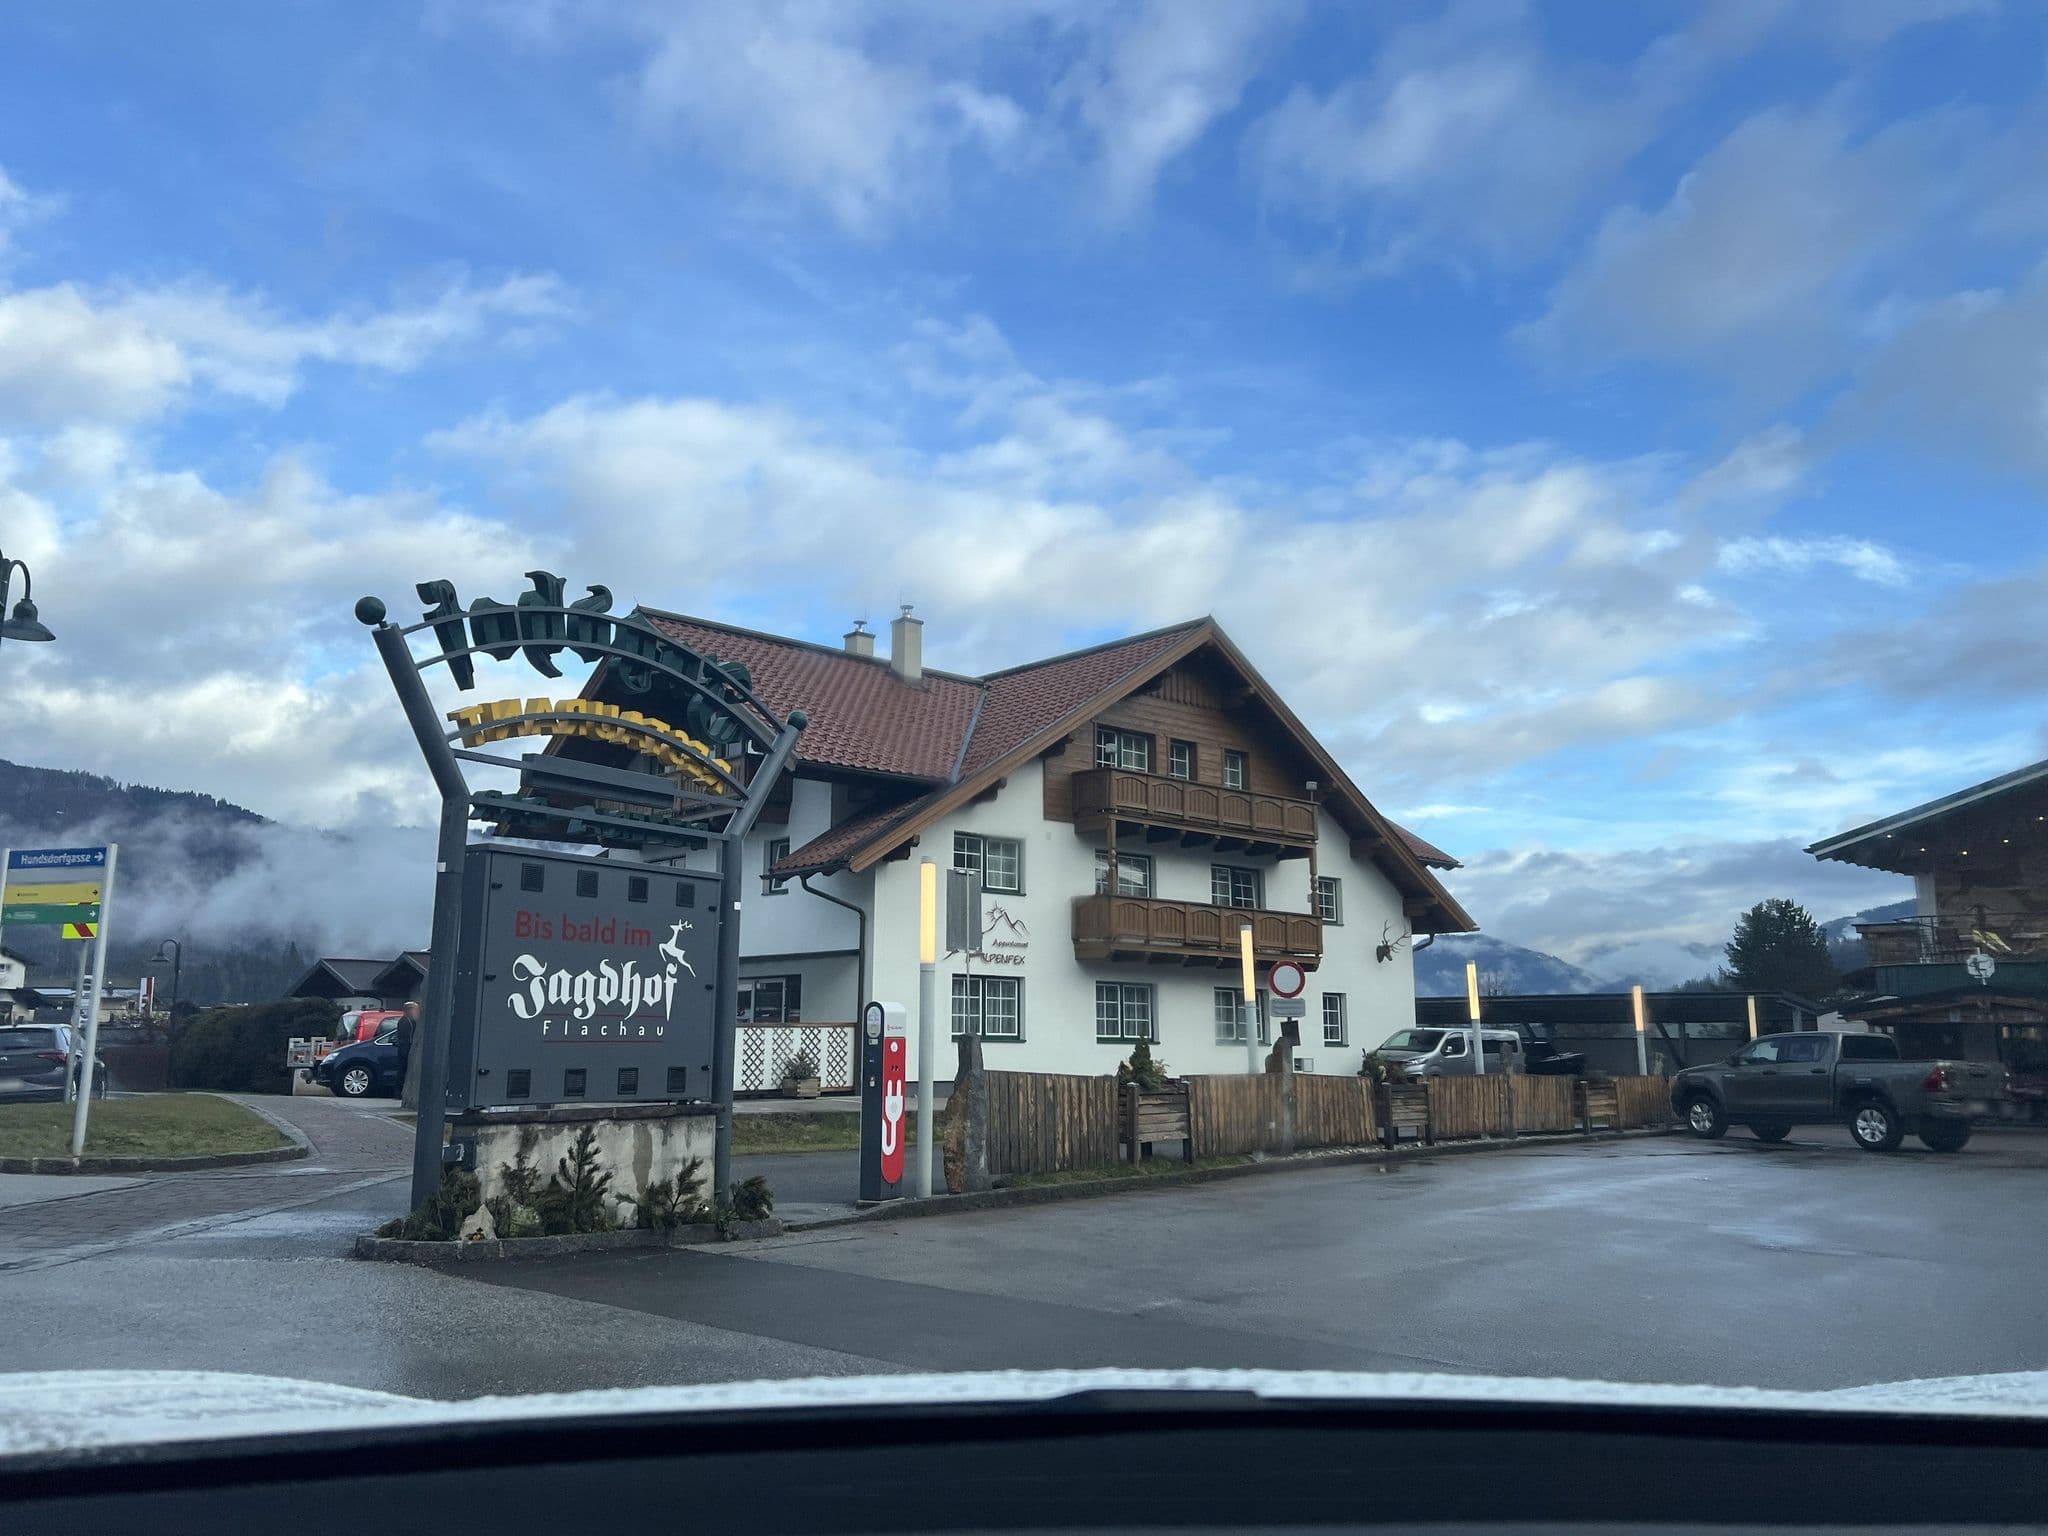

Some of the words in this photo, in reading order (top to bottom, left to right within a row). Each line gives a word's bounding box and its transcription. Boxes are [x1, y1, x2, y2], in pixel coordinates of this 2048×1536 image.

[20, 852, 91, 865] Hundsdorfgasse
[515, 910, 553, 939] Bis
[561, 913, 616, 945] bald
[624, 921, 652, 947] im
[508, 954, 678, 1021] Jagdhof
[543, 1020, 664, 1036] Flachau
